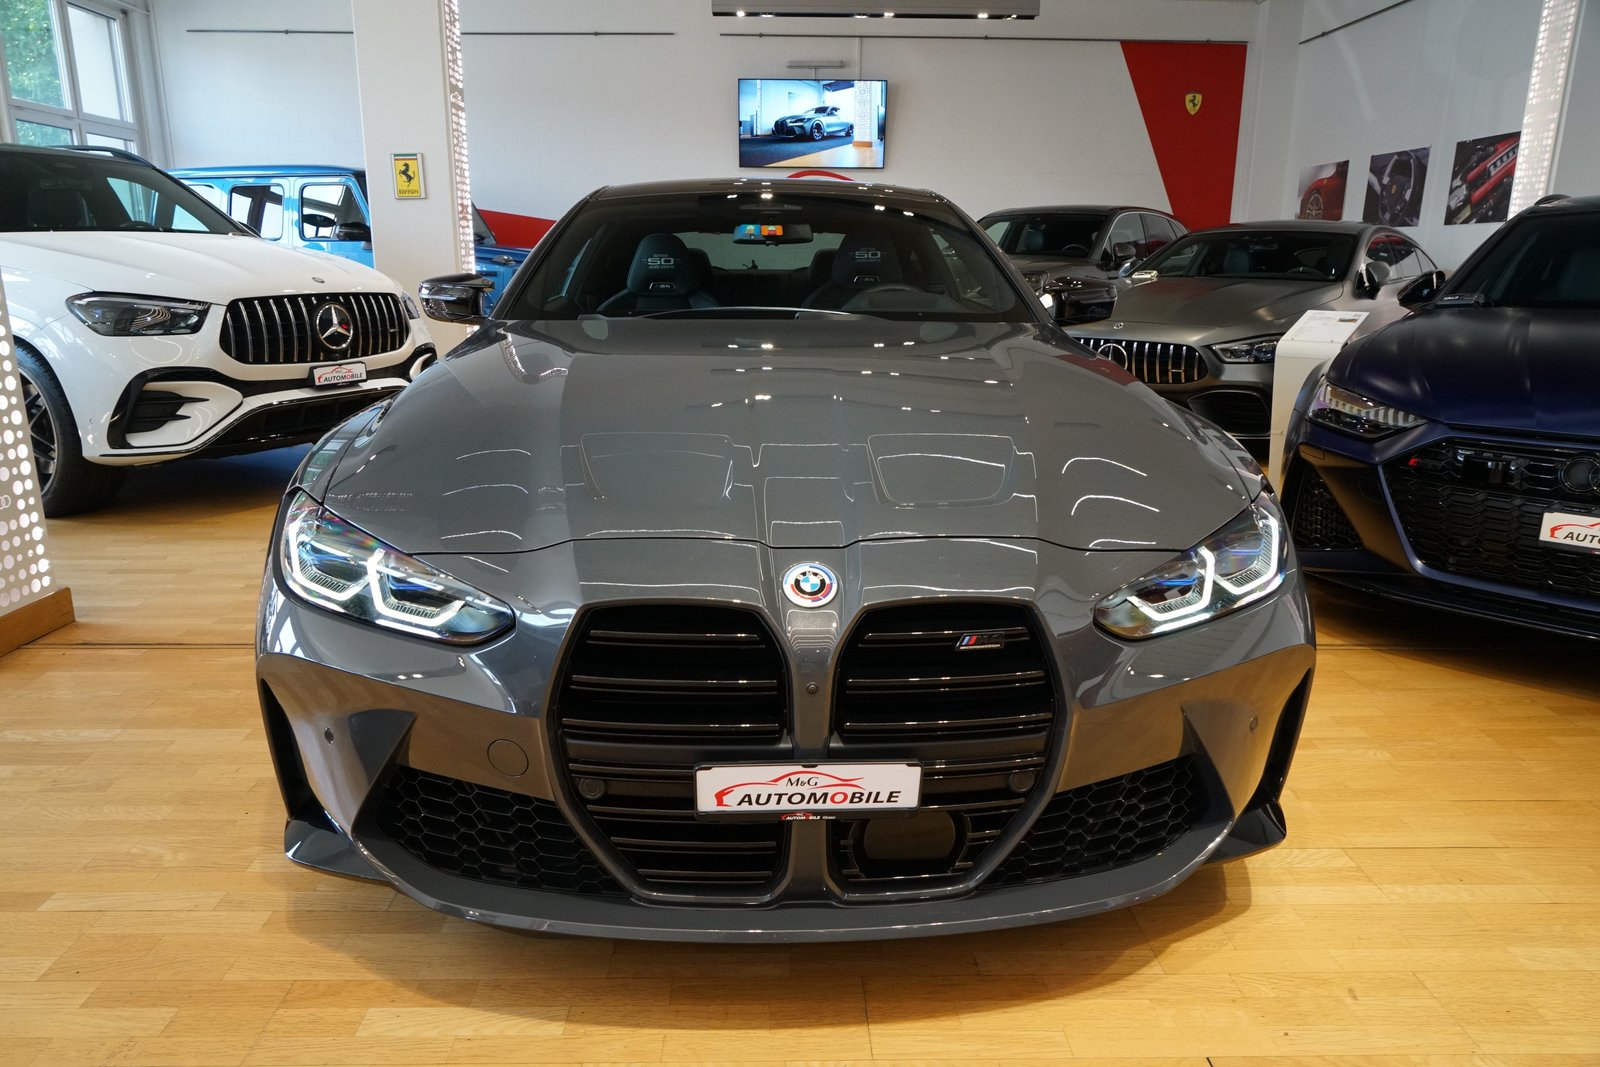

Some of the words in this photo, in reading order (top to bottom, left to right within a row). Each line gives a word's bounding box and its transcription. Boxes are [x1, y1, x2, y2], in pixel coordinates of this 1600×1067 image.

[855, 251, 881, 259] 50
[647, 257, 675, 265] 50
[323, 372, 364, 383] AUTOMOBILE
[1563, 531, 1600, 545] AUT
[786, 776, 819, 787] M&G
[736, 790, 902, 807] AUTOMOBILE
